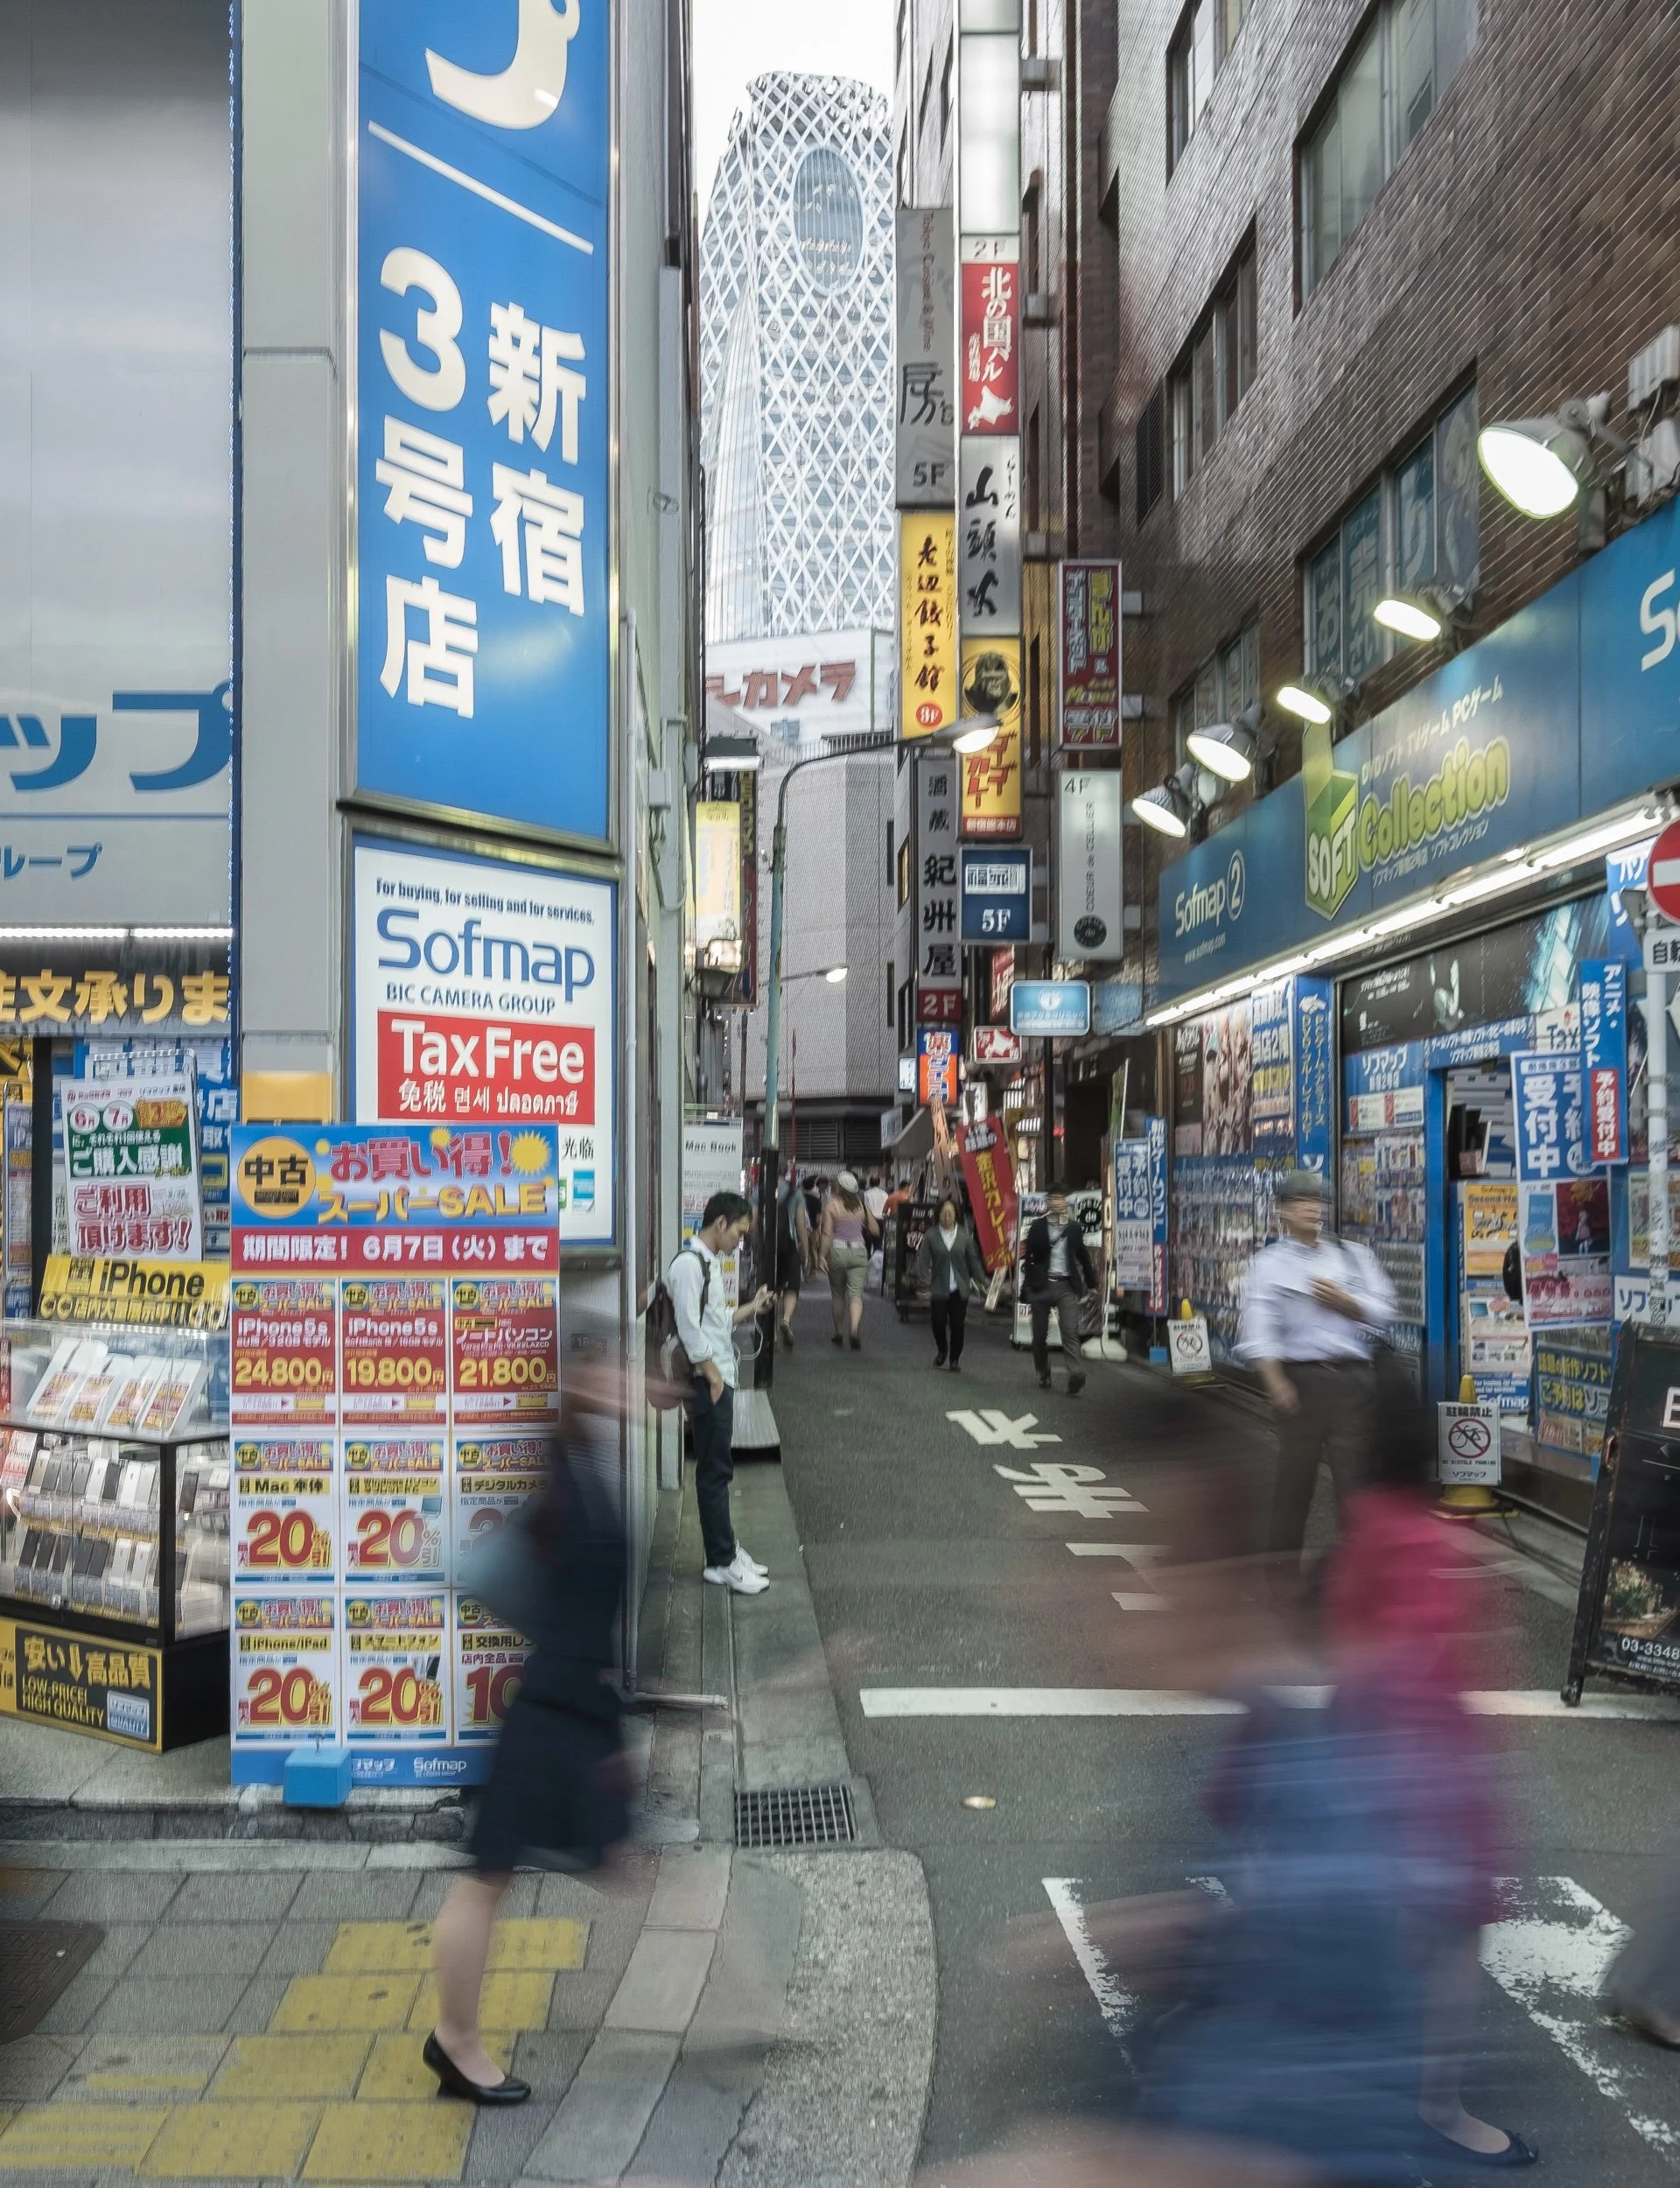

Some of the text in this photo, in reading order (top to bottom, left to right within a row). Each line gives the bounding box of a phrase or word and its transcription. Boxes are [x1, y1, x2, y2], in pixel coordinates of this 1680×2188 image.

[487, 301, 587, 617] 新宿
[912, 459, 946, 488] 5F
[375, 246, 479, 719] 3号店
[965, 464, 999, 620] 山頭火
[1306, 735, 1511, 899] SOFT Collection
[377, 876, 396, 898] For
[444, 886, 462, 905] for
[464, 891, 504, 912] selling
[507, 896, 527, 915] and
[528, 899, 545, 917] for
[923, 853, 957, 978] 紀州屋
[1175, 877, 1226, 938] Sofmap
[982, 908, 1012, 933] 5F
[377, 907, 596, 1004] Sofmap
[386, 983, 556, 1016] BIC CAMERA GROUP
[924, 993, 956, 1016] 2F
[1581, 981, 1601, 1069] 映像ソフト
[391, 1019, 585, 1084] Tax Free
[398, 1079, 447, 1114] 免税
[1523, 1074, 1560, 1179] 受付中
[244, 1153, 309, 1189] 中古
[74, 1182, 150, 1220] ご利用
[243, 1234, 348, 1263] 期間限定!
[99, 1259, 206, 1298] iPhone
[456, 1327, 554, 1346] ノートパソコン
[1446, 1406, 1493, 1418] 駐輪禁止
[255, 1477, 290, 1494] Mac
[460, 1603, 481, 1615] 中古
[24, 1635, 66, 1673] 安い
[86, 1651, 151, 1690] 高品質
[462, 1652, 508, 1665] 店内全品
[53, 1699, 105, 1727] QUALITY
